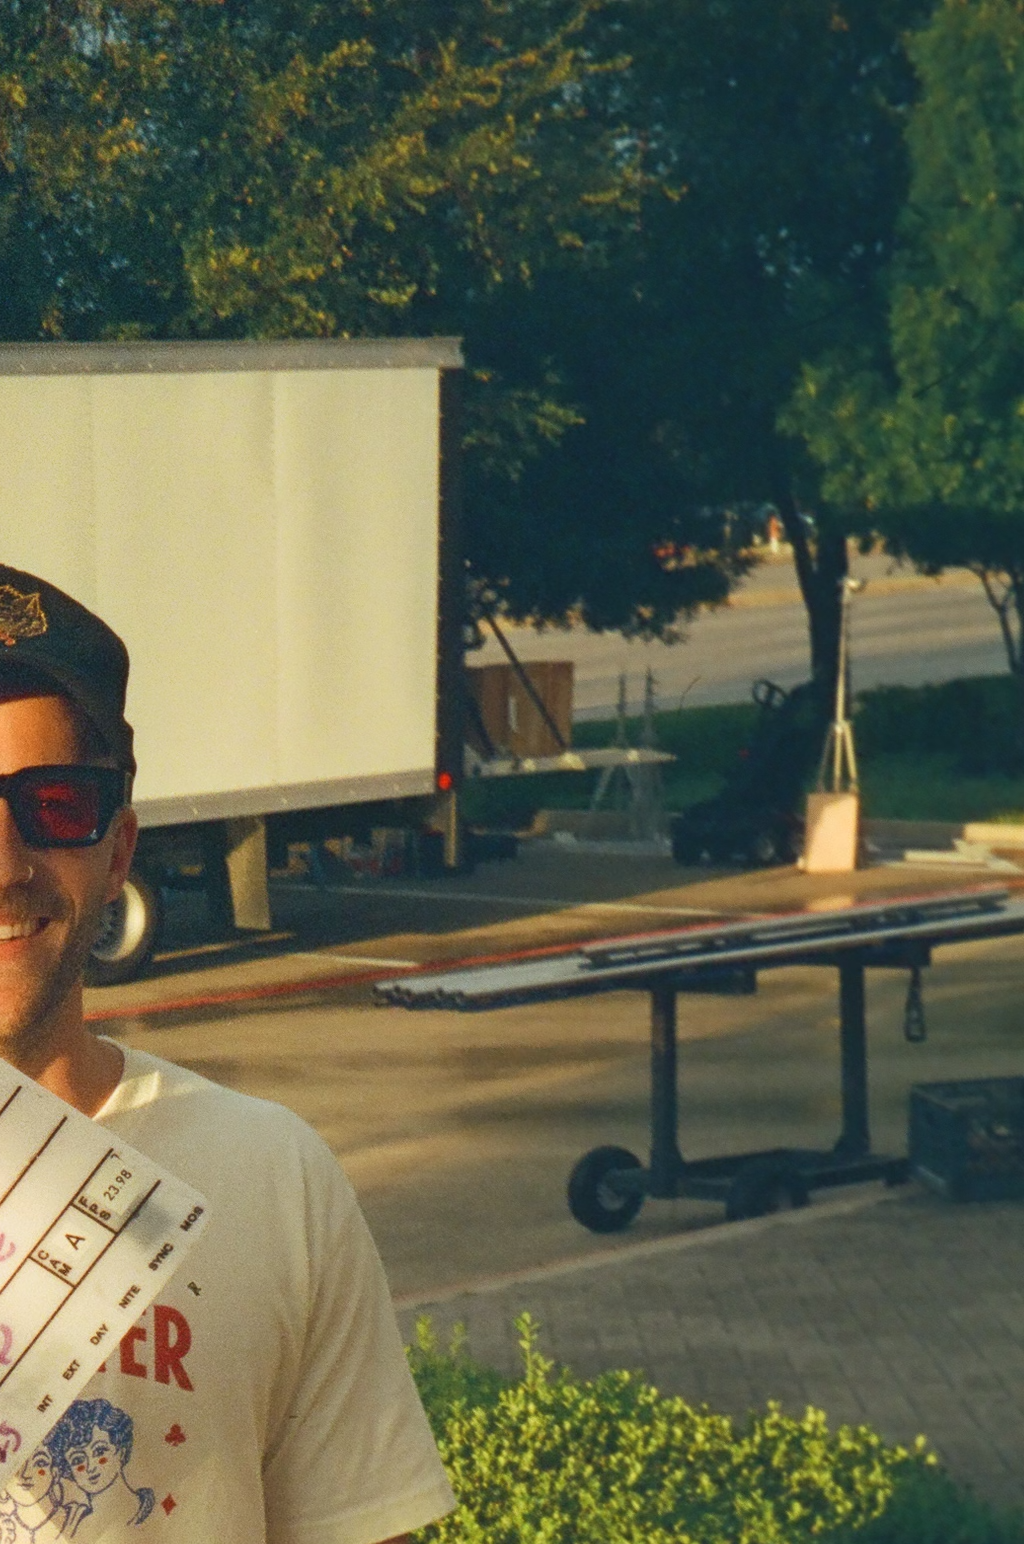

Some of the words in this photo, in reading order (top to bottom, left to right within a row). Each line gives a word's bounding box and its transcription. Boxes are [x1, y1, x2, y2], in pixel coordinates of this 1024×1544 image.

[103, 1168, 133, 1202] 23.98
[78, 1195, 112, 1221] FPS
[64, 1233, 86, 1251] A
[37, 1249, 73, 1277] CAM
[37, 1394, 54, 1414] INT
[62, 1358, 81, 1381] EXT
[89, 1323, 110, 1346] DAY
[118, 1284, 141, 1309] NITE
[148, 1242, 174, 1271] SYNC
[180, 1205, 205, 1232] MOS
